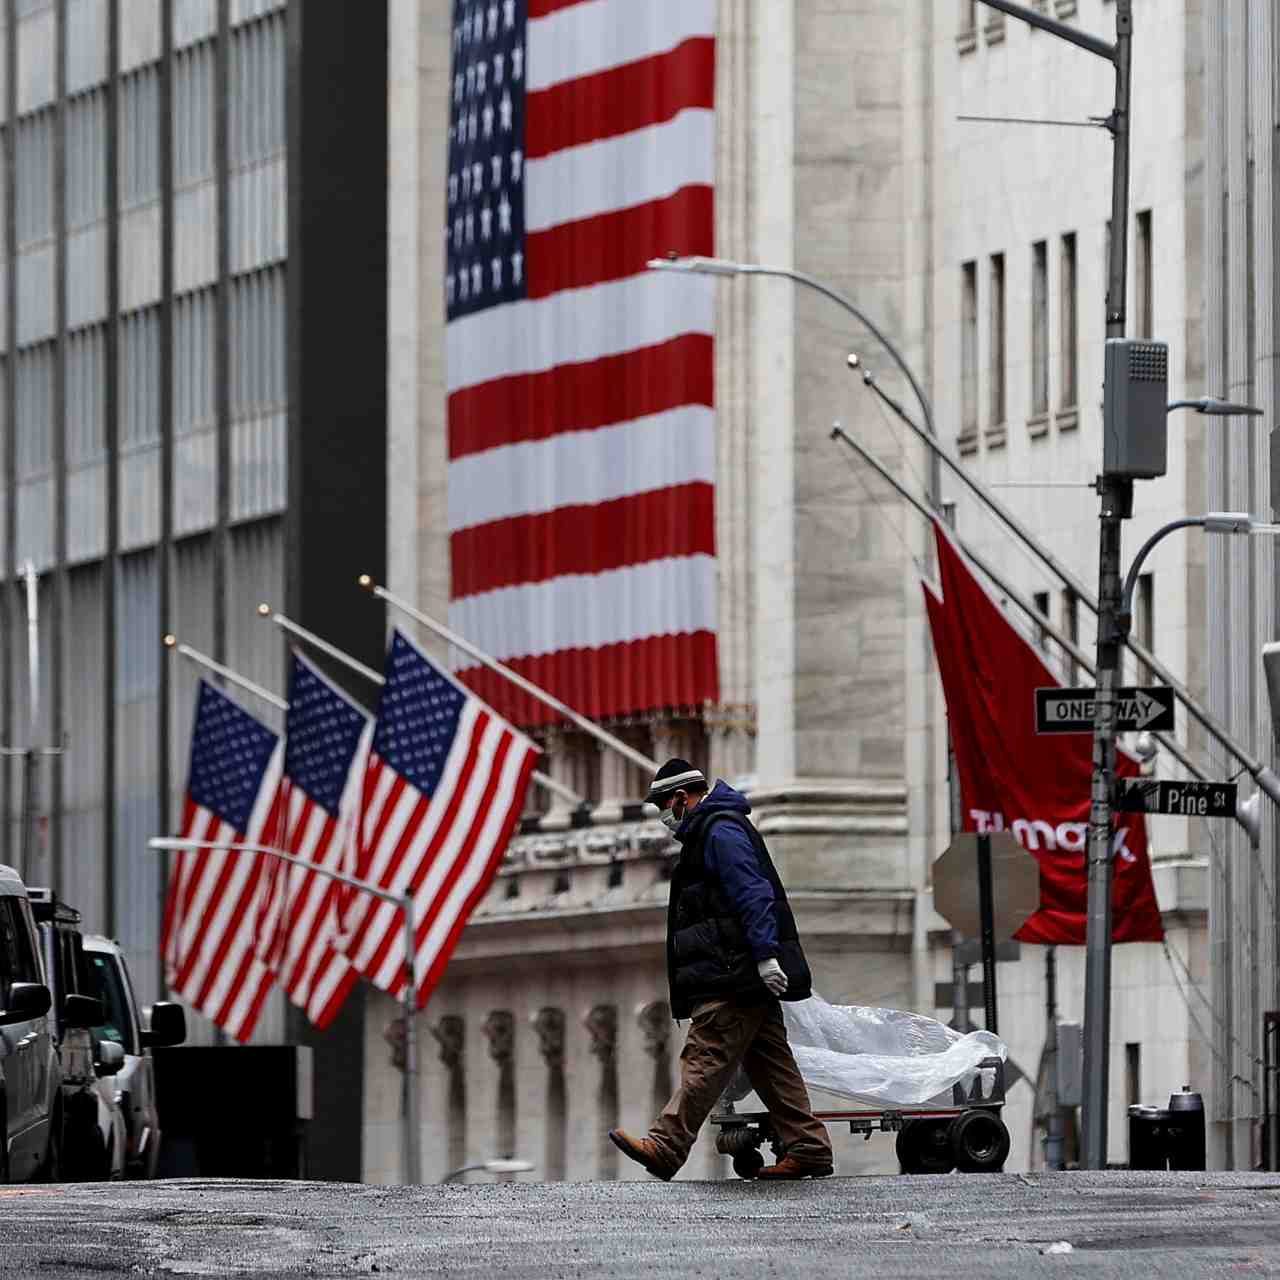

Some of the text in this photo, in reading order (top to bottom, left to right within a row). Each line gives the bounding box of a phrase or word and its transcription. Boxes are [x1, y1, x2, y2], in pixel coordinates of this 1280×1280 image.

[1056, 701, 1098, 719] ONE
[1167, 788, 1226, 815] Pine St
